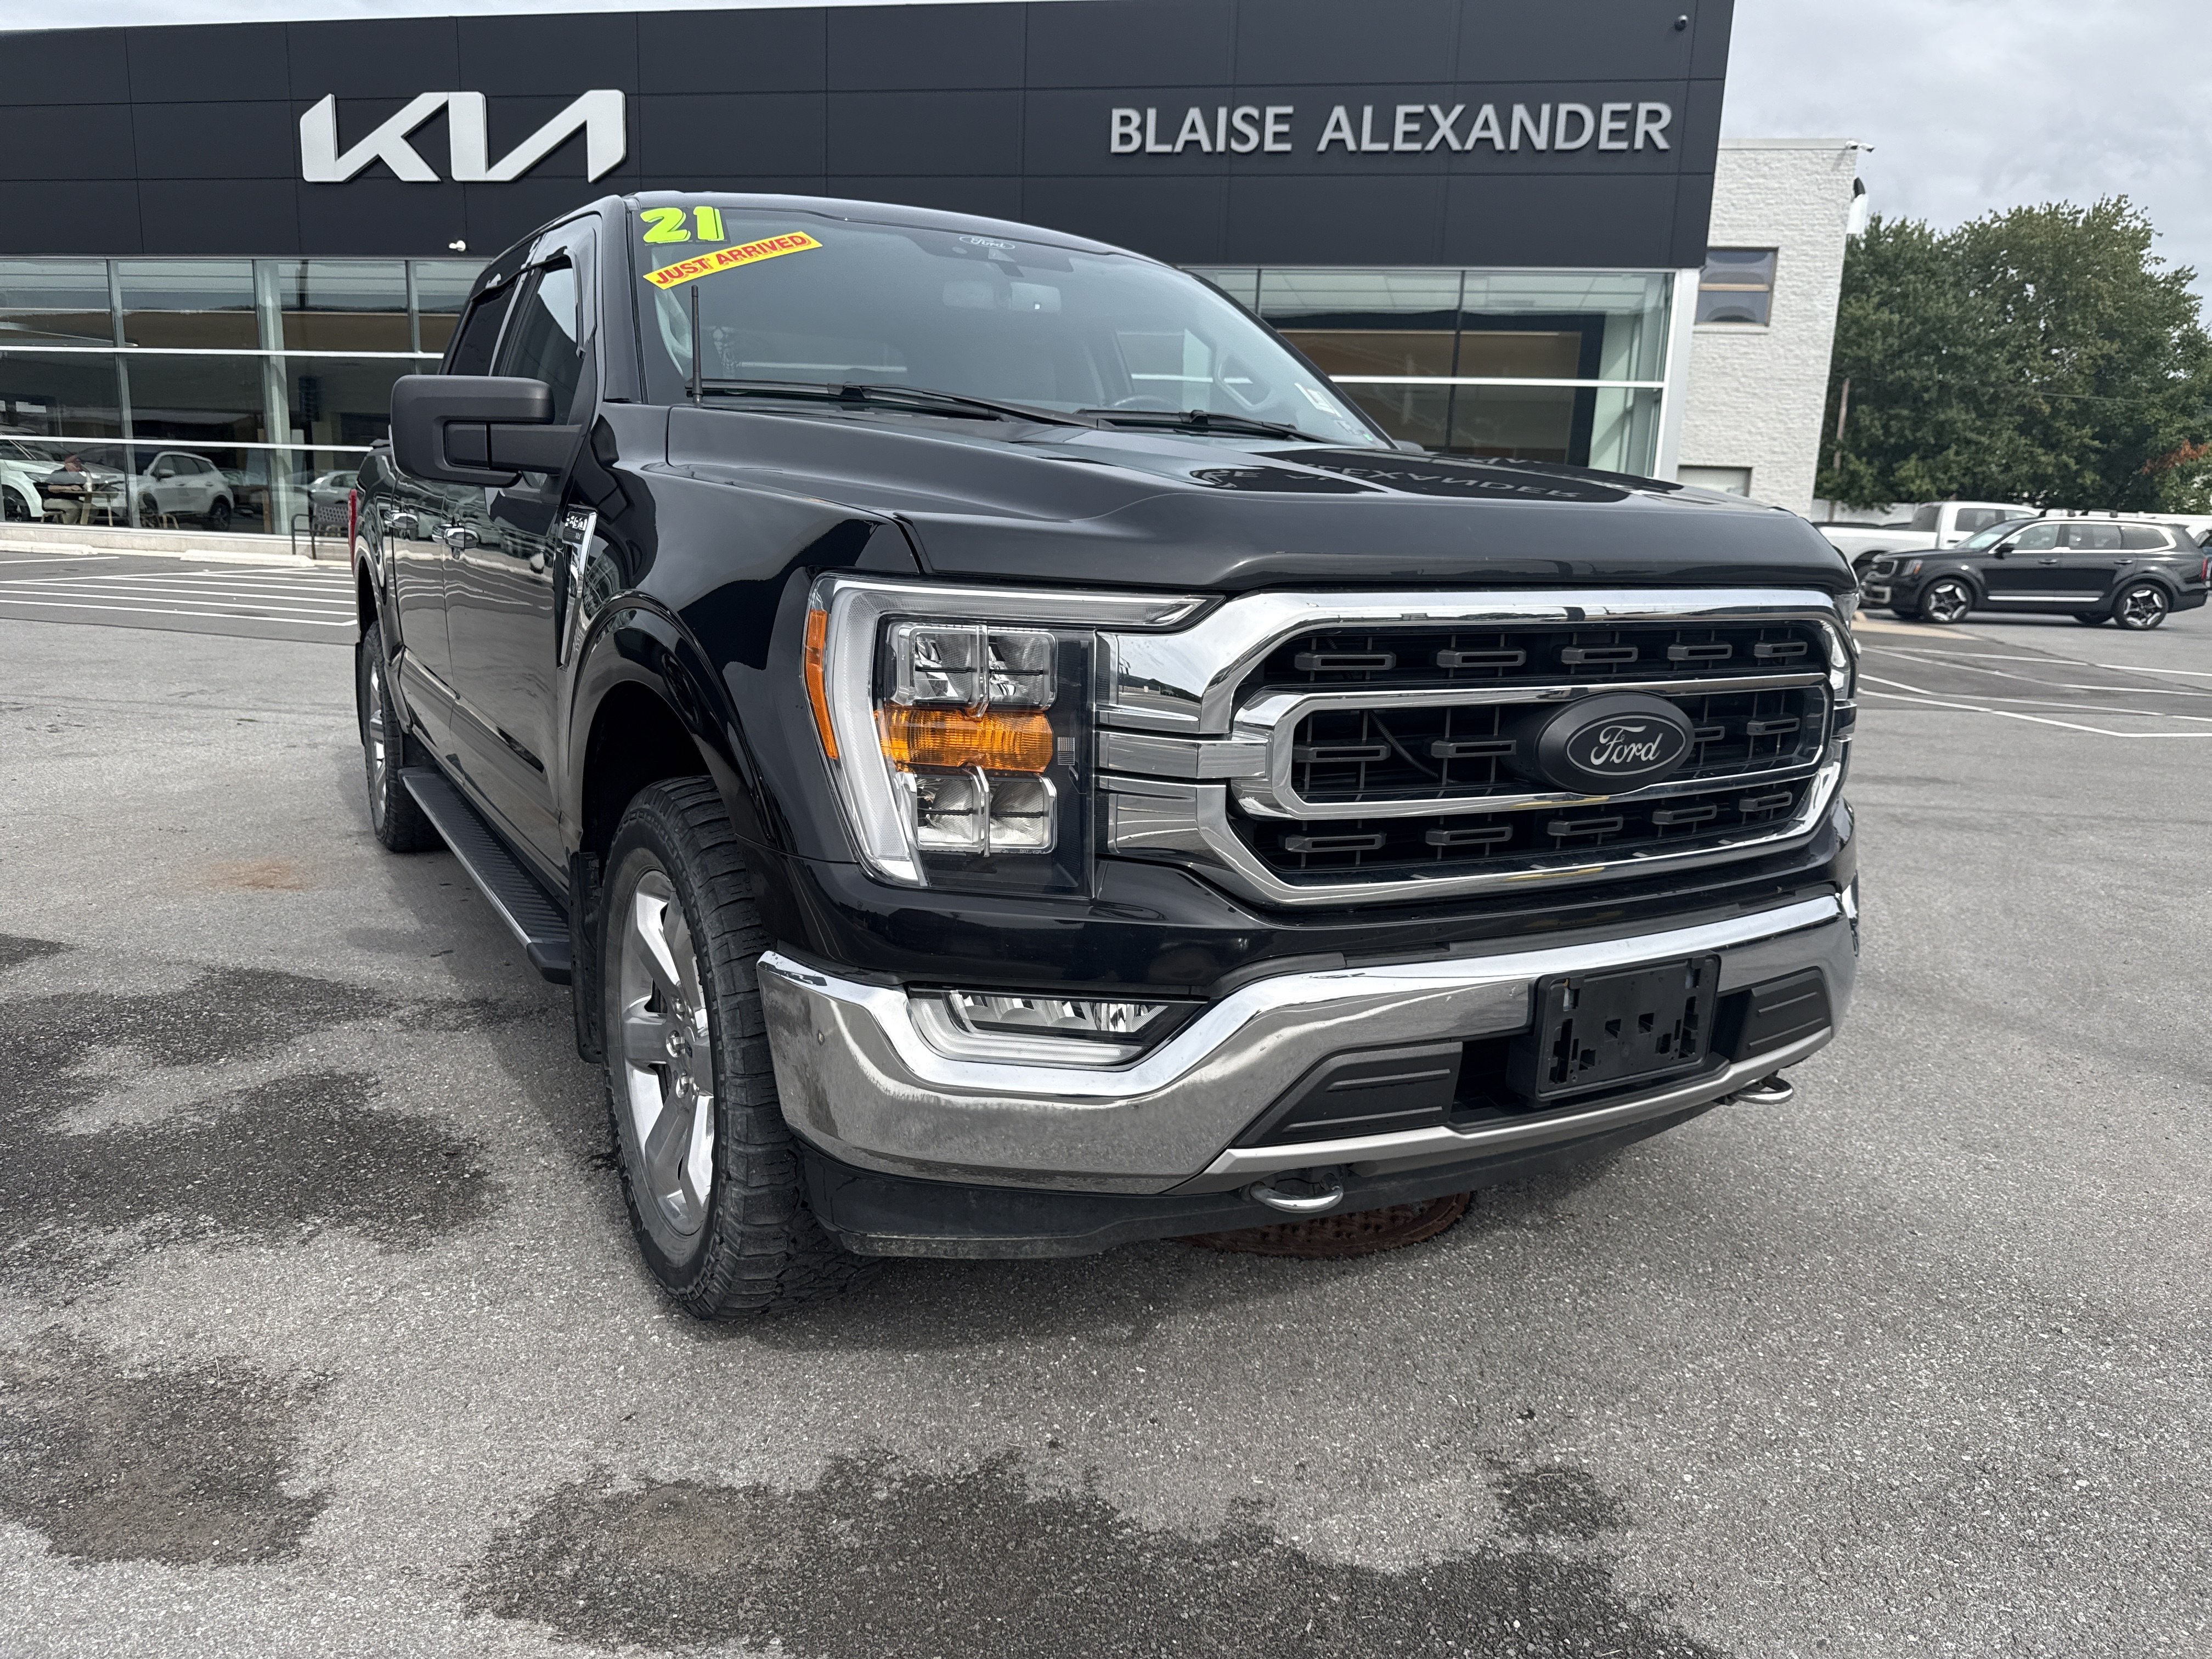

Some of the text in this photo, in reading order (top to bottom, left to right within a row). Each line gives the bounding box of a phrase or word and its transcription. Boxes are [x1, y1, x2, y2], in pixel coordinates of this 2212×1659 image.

[300, 89, 627, 183] KIA
[1110, 101, 1672, 154] BLAISE ALEXANDER
[640, 206, 725, 244] 21
[970, 236, 1006, 248] Ford
[656, 235, 812, 285] JUST ARRIVED
[1590, 725, 1664, 766] Ford
